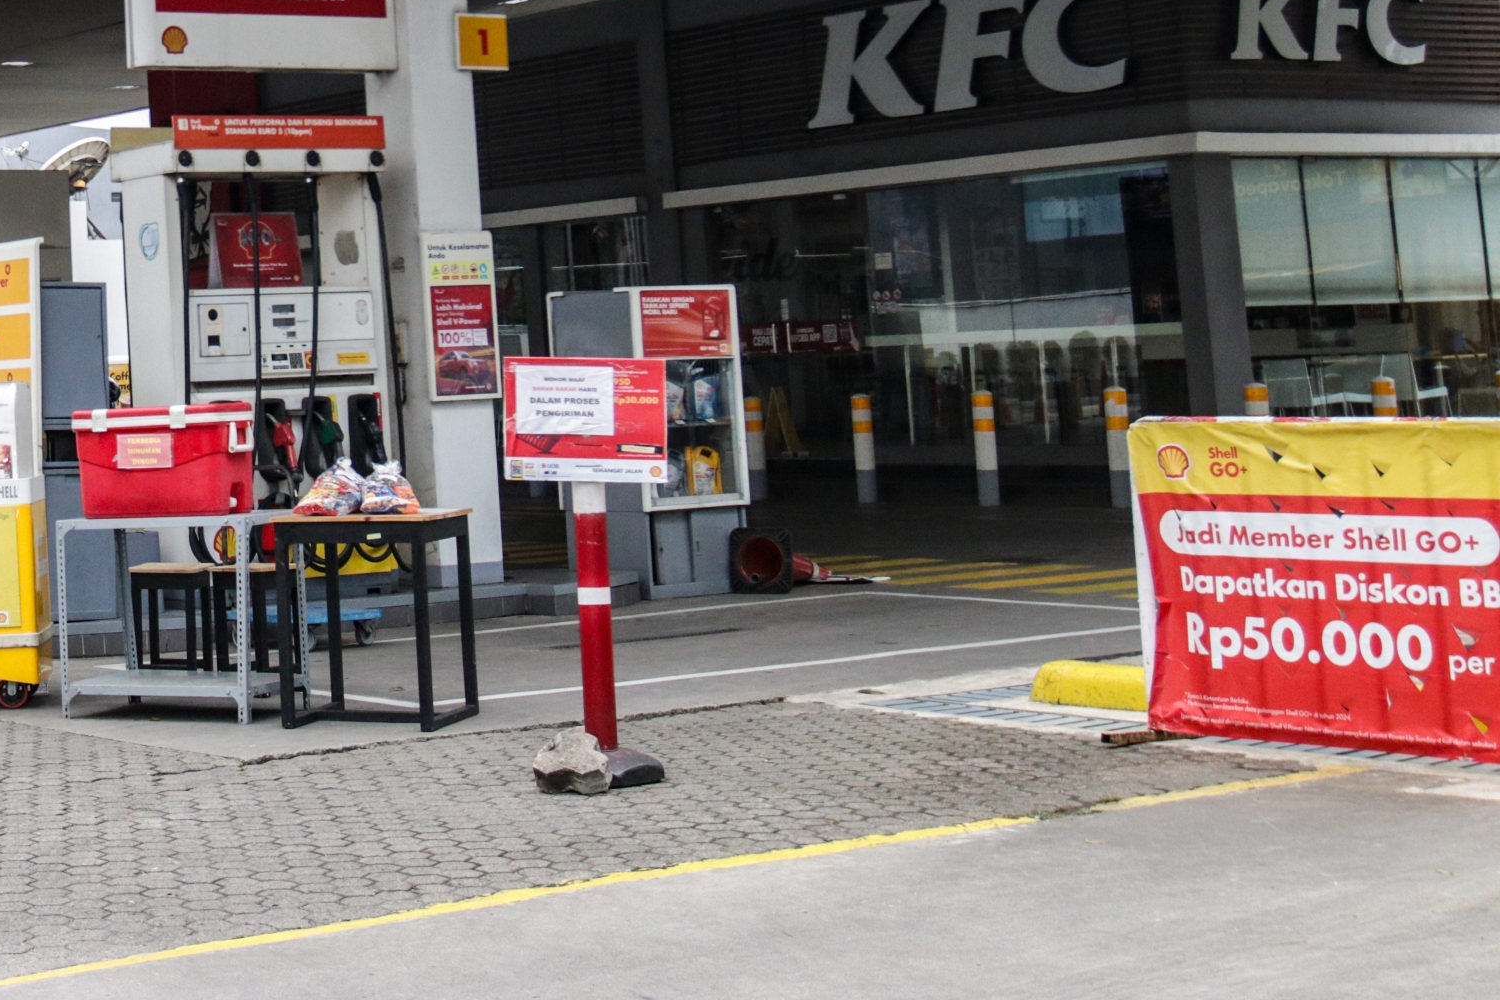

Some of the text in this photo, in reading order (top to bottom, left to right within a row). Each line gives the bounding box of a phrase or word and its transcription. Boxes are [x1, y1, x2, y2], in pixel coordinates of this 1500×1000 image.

[477, 28, 490, 56] 1
[448, 243, 490, 251] Keselamatan
[440, 331, 472, 344] 100%
[564, 397, 600, 405] PROSES
[535, 410, 594, 418] PENGIRIMAN
[1208, 446, 1238, 459] Shell
[1209, 461, 1248, 478] GO+
[1176, 522, 1480, 554] Jadi Member Shell GO+
[1180, 565, 1326, 603] Dapatkan
[1335, 572, 1449, 607] Diskon
[1186, 611, 1496, 681] Rp50.000 per
